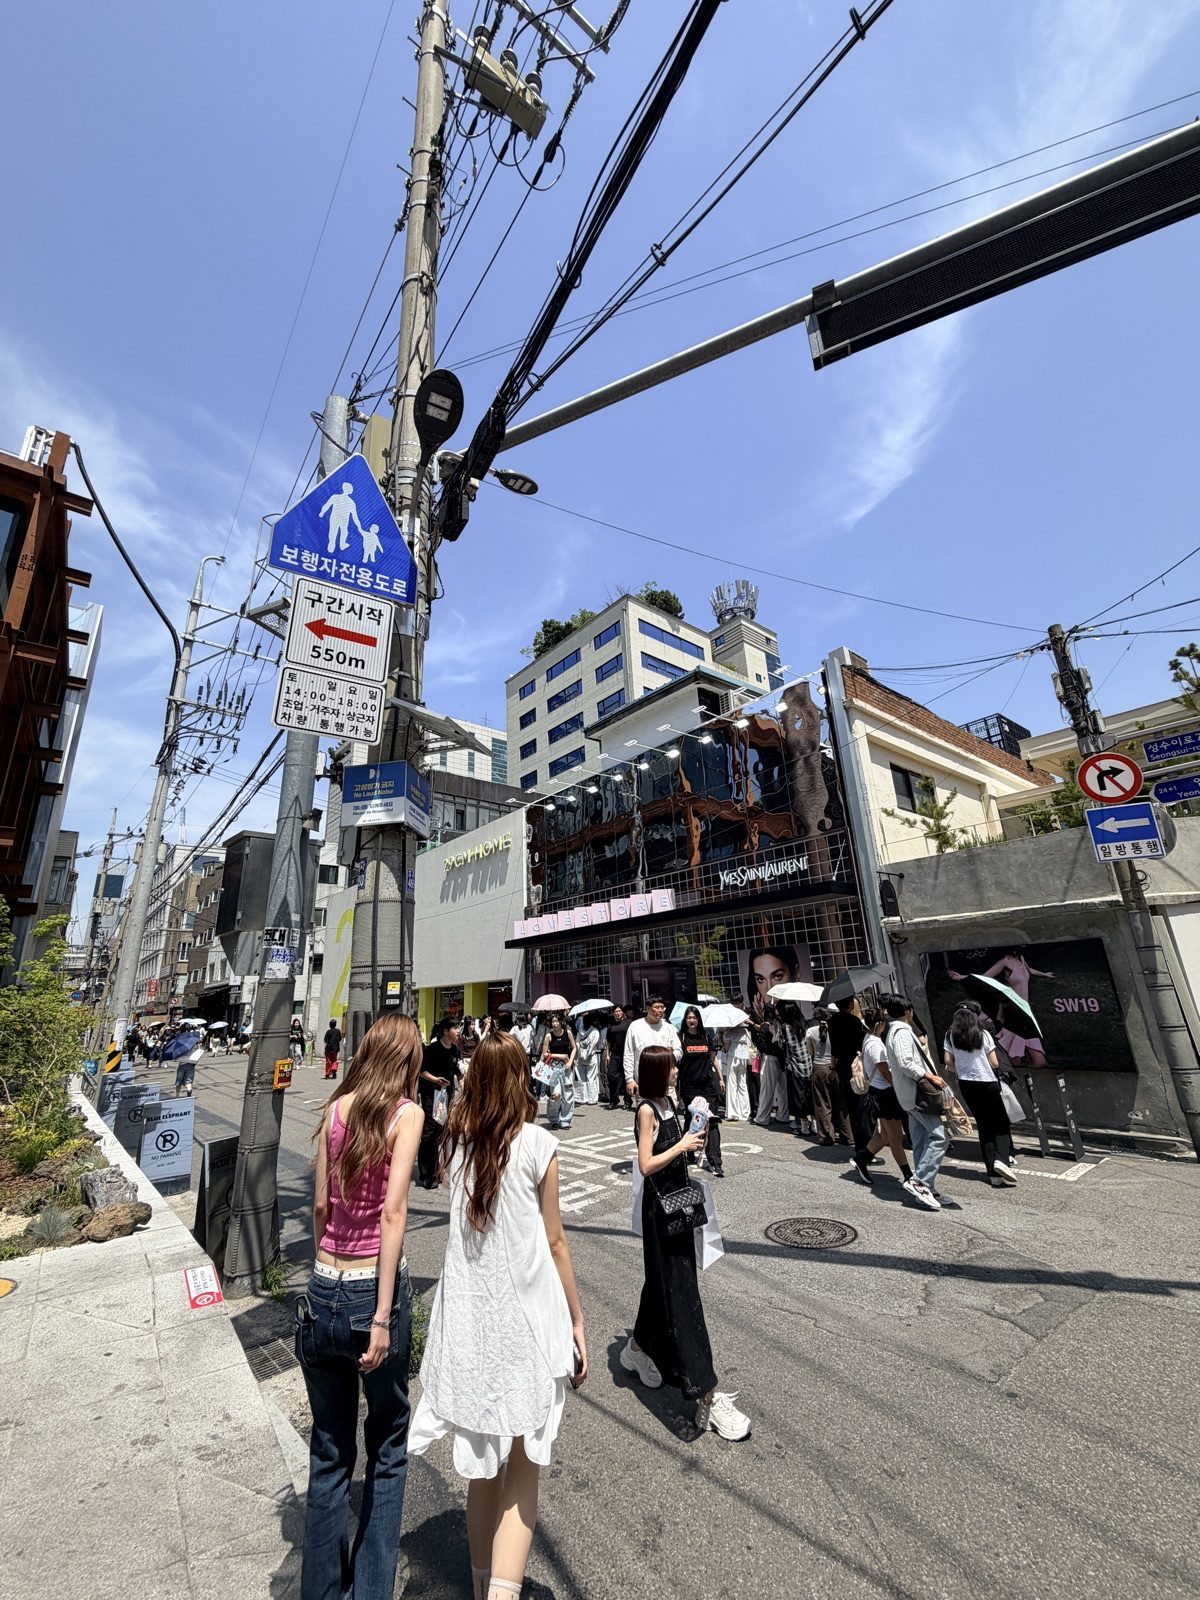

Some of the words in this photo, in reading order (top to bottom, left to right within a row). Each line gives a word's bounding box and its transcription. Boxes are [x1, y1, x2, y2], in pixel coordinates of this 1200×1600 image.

[279, 544, 408, 598] 보행자전용도로
[304, 590, 384, 626] 구간시작
[310, 645, 366, 670] 550m
[362, 789, 377, 797] Loud
[378, 788, 394, 796] Noise
[1100, 840, 1160, 858] 일방통행
[1053, 998, 1101, 1014] SW19
[147, 1114, 161, 1122] BLUE
[162, 1110, 191, 1120] ELEPHANT
[160, 1151, 182, 1160] PARKING
